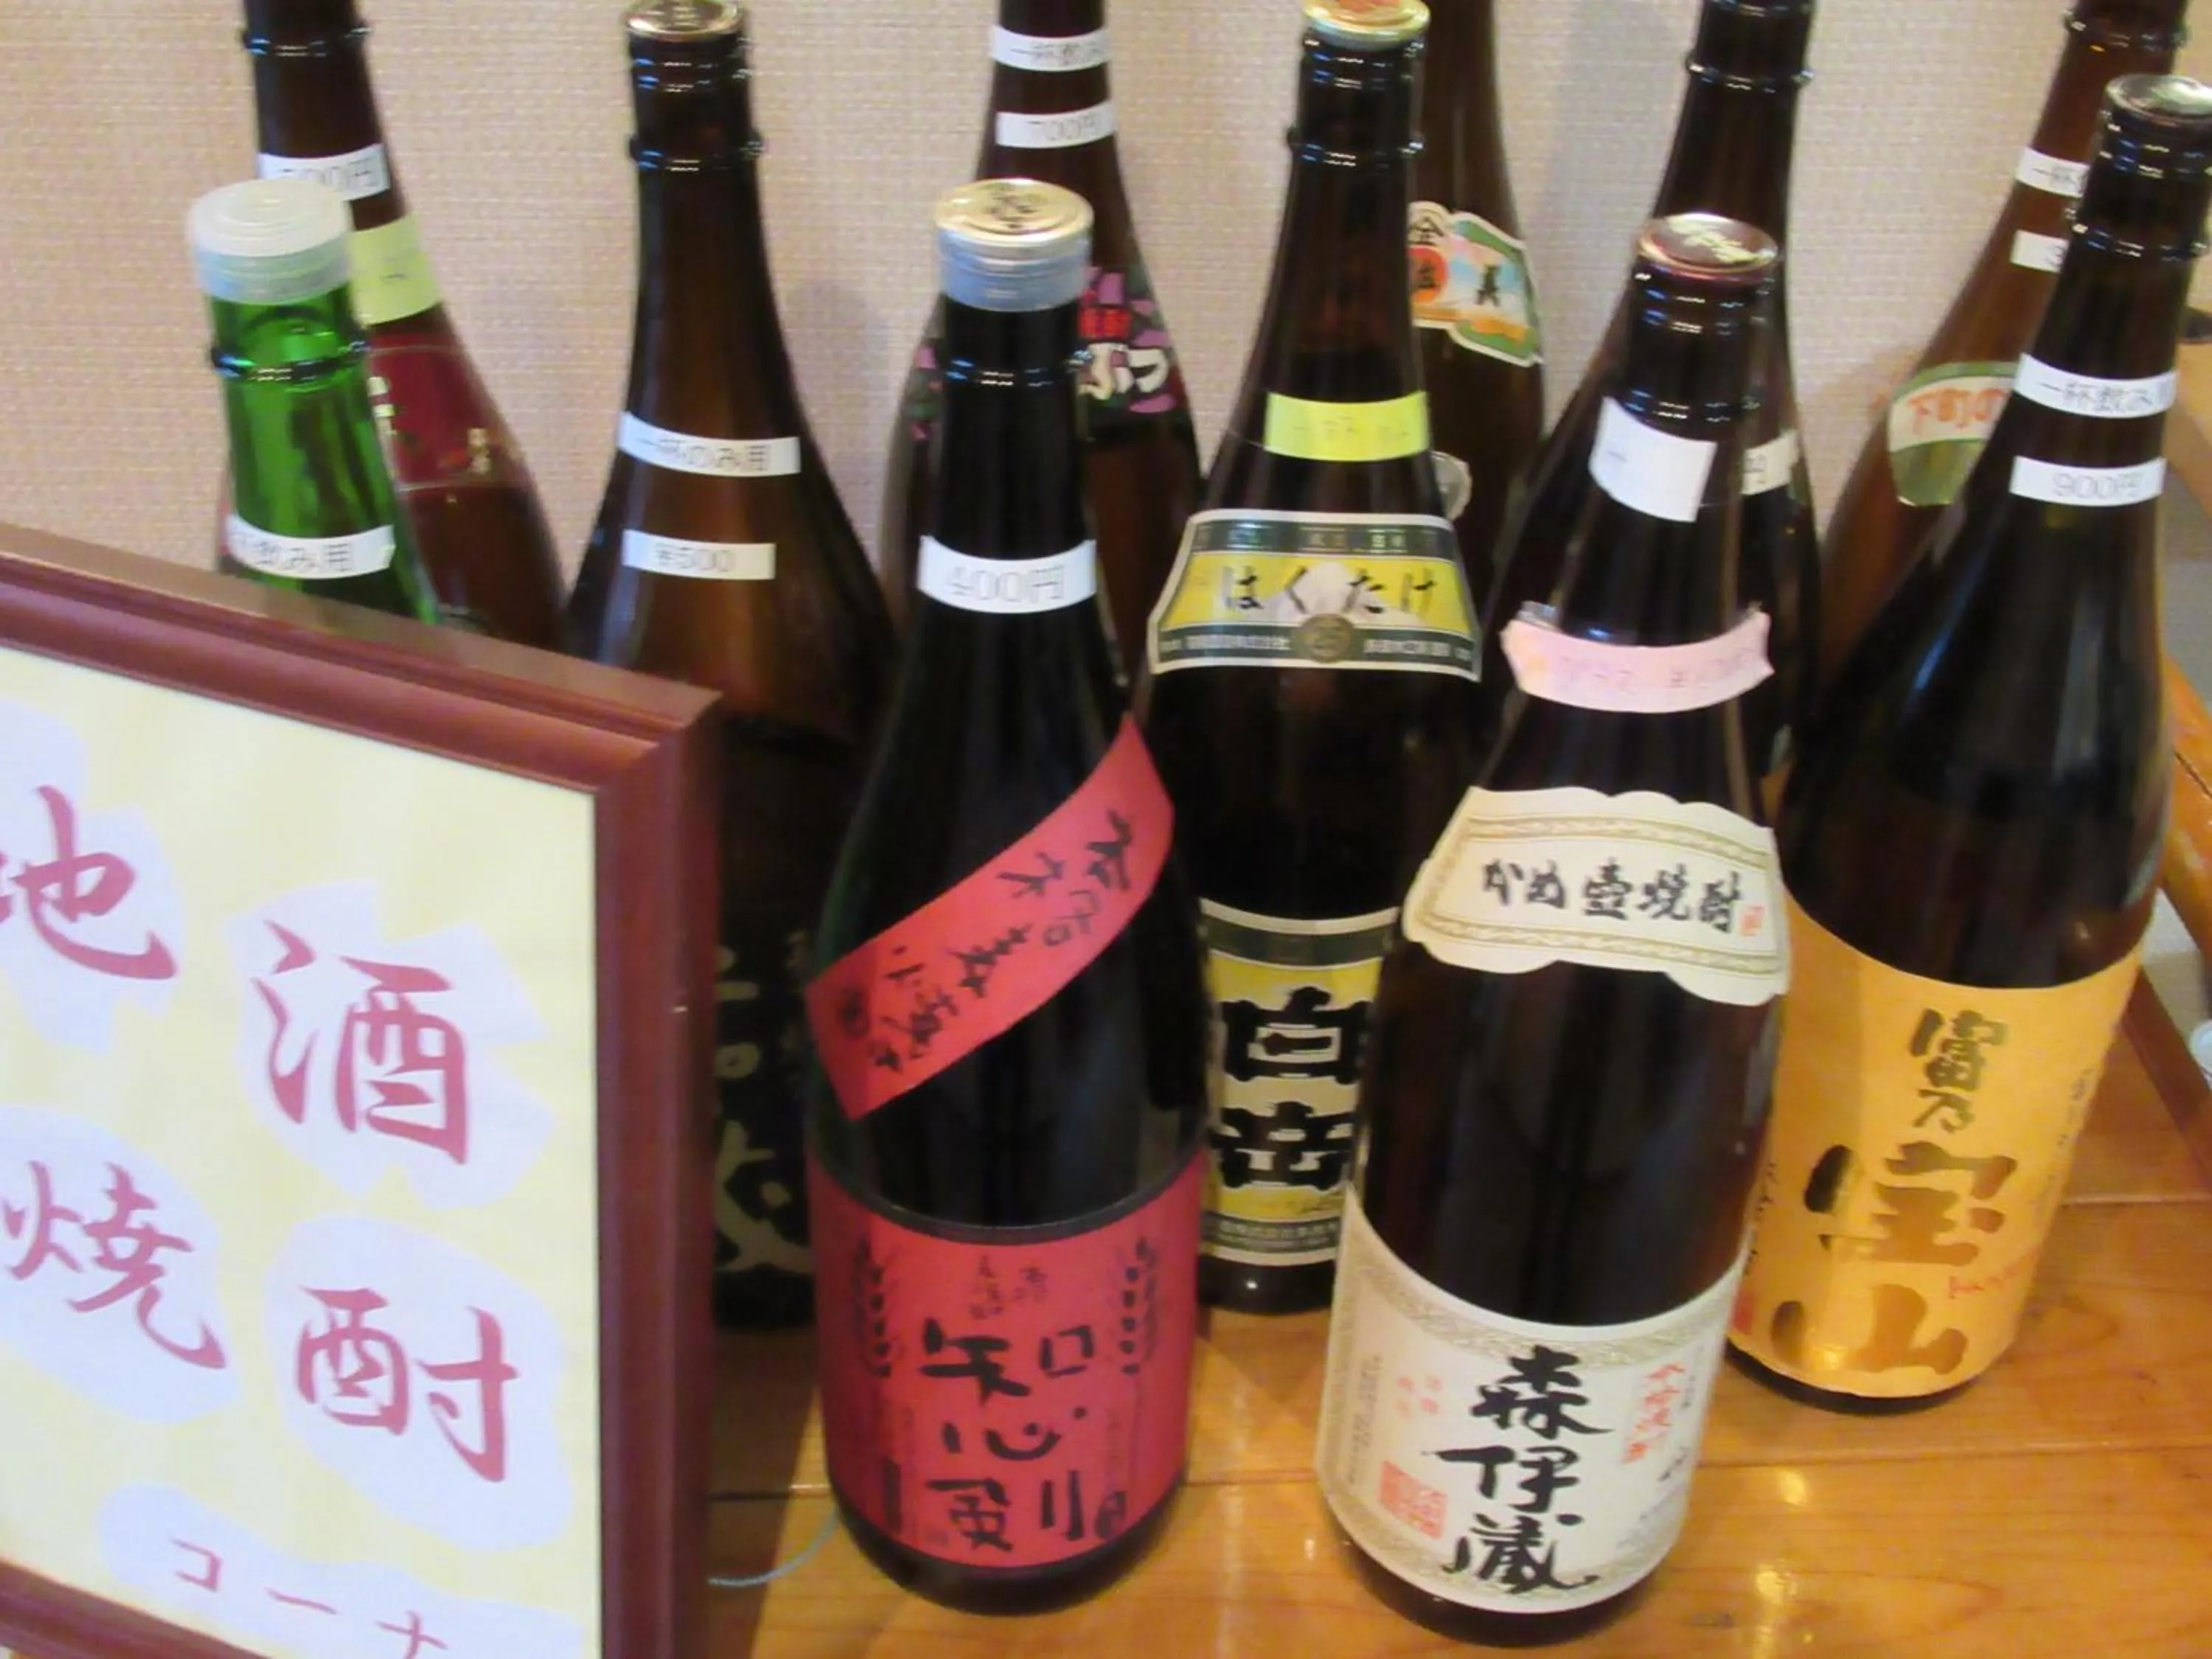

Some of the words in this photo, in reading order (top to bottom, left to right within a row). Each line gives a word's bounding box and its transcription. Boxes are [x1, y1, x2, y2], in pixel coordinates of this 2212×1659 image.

[1220, 563, 1439, 615] はくたけ
[1208, 986, 1374, 1192] 白岳
[1771, 1007, 2019, 1376] 富乃宝山
[2, 1160, 521, 1483] 焼酎
